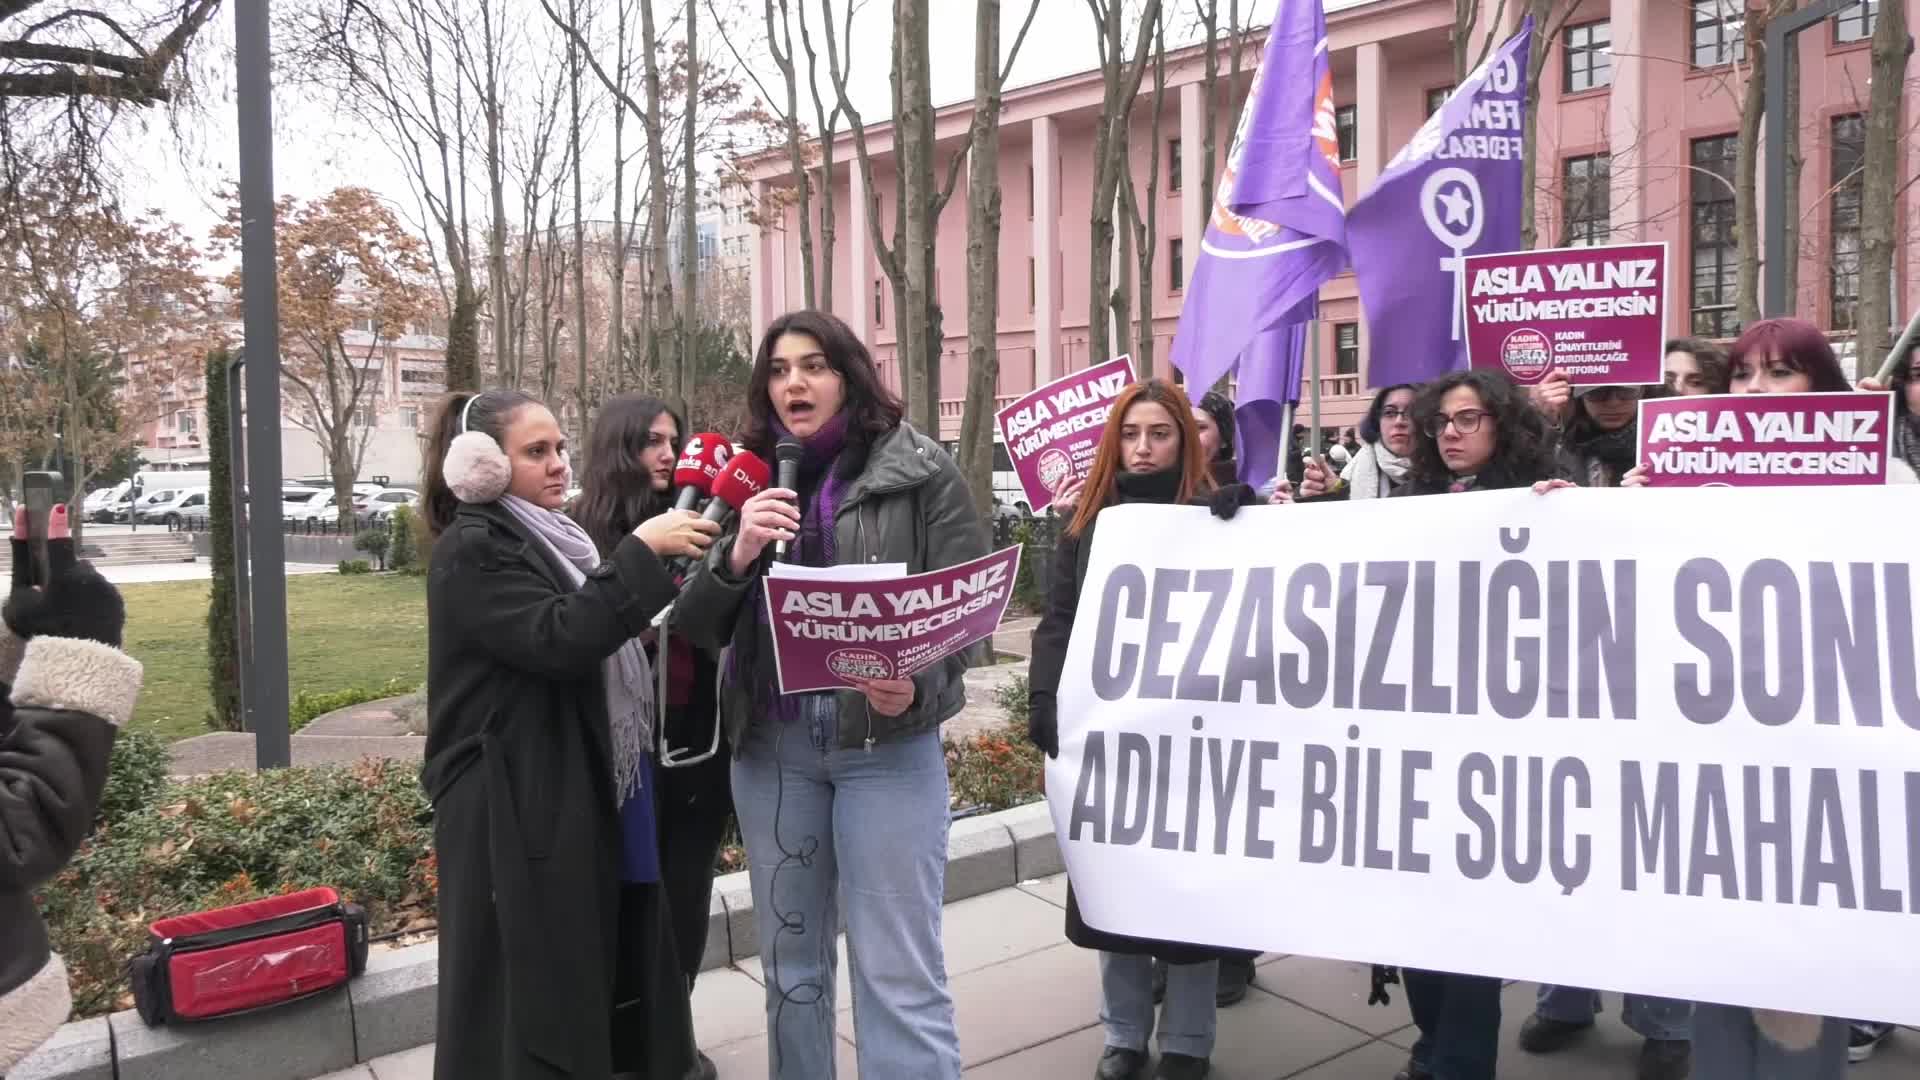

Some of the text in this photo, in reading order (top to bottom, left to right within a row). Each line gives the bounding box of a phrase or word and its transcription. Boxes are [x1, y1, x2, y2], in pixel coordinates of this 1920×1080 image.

[1472, 259, 1657, 296] ASLA YALNIZ
[1473, 290, 1657, 323] YÜRÜMEYECEKSİN
[1555, 331, 1585, 341] KADIN
[1006, 370, 1127, 442] ASLA YALNIZ
[1012, 404, 1115, 460] YÜRÜMEYECEK
[1648, 410, 1880, 443] ASLA YALNIZ
[1648, 446, 1879, 475] YÜRÜMEYECEKSİN
[781, 560, 1009, 618] ASLA YALNIZ
[784, 586, 1004, 642] YÜRÜMEYECEKSİN
[1091, 527, 1637, 720] CEZASIZLIĞIN
[840, 652, 877, 661] KADIN
[897, 642, 930, 658] KADIN
[1069, 715, 1279, 860] ADLİYE
[1299, 724, 1432, 873] BİLE
[1455, 752, 1592, 896] SUÇ
